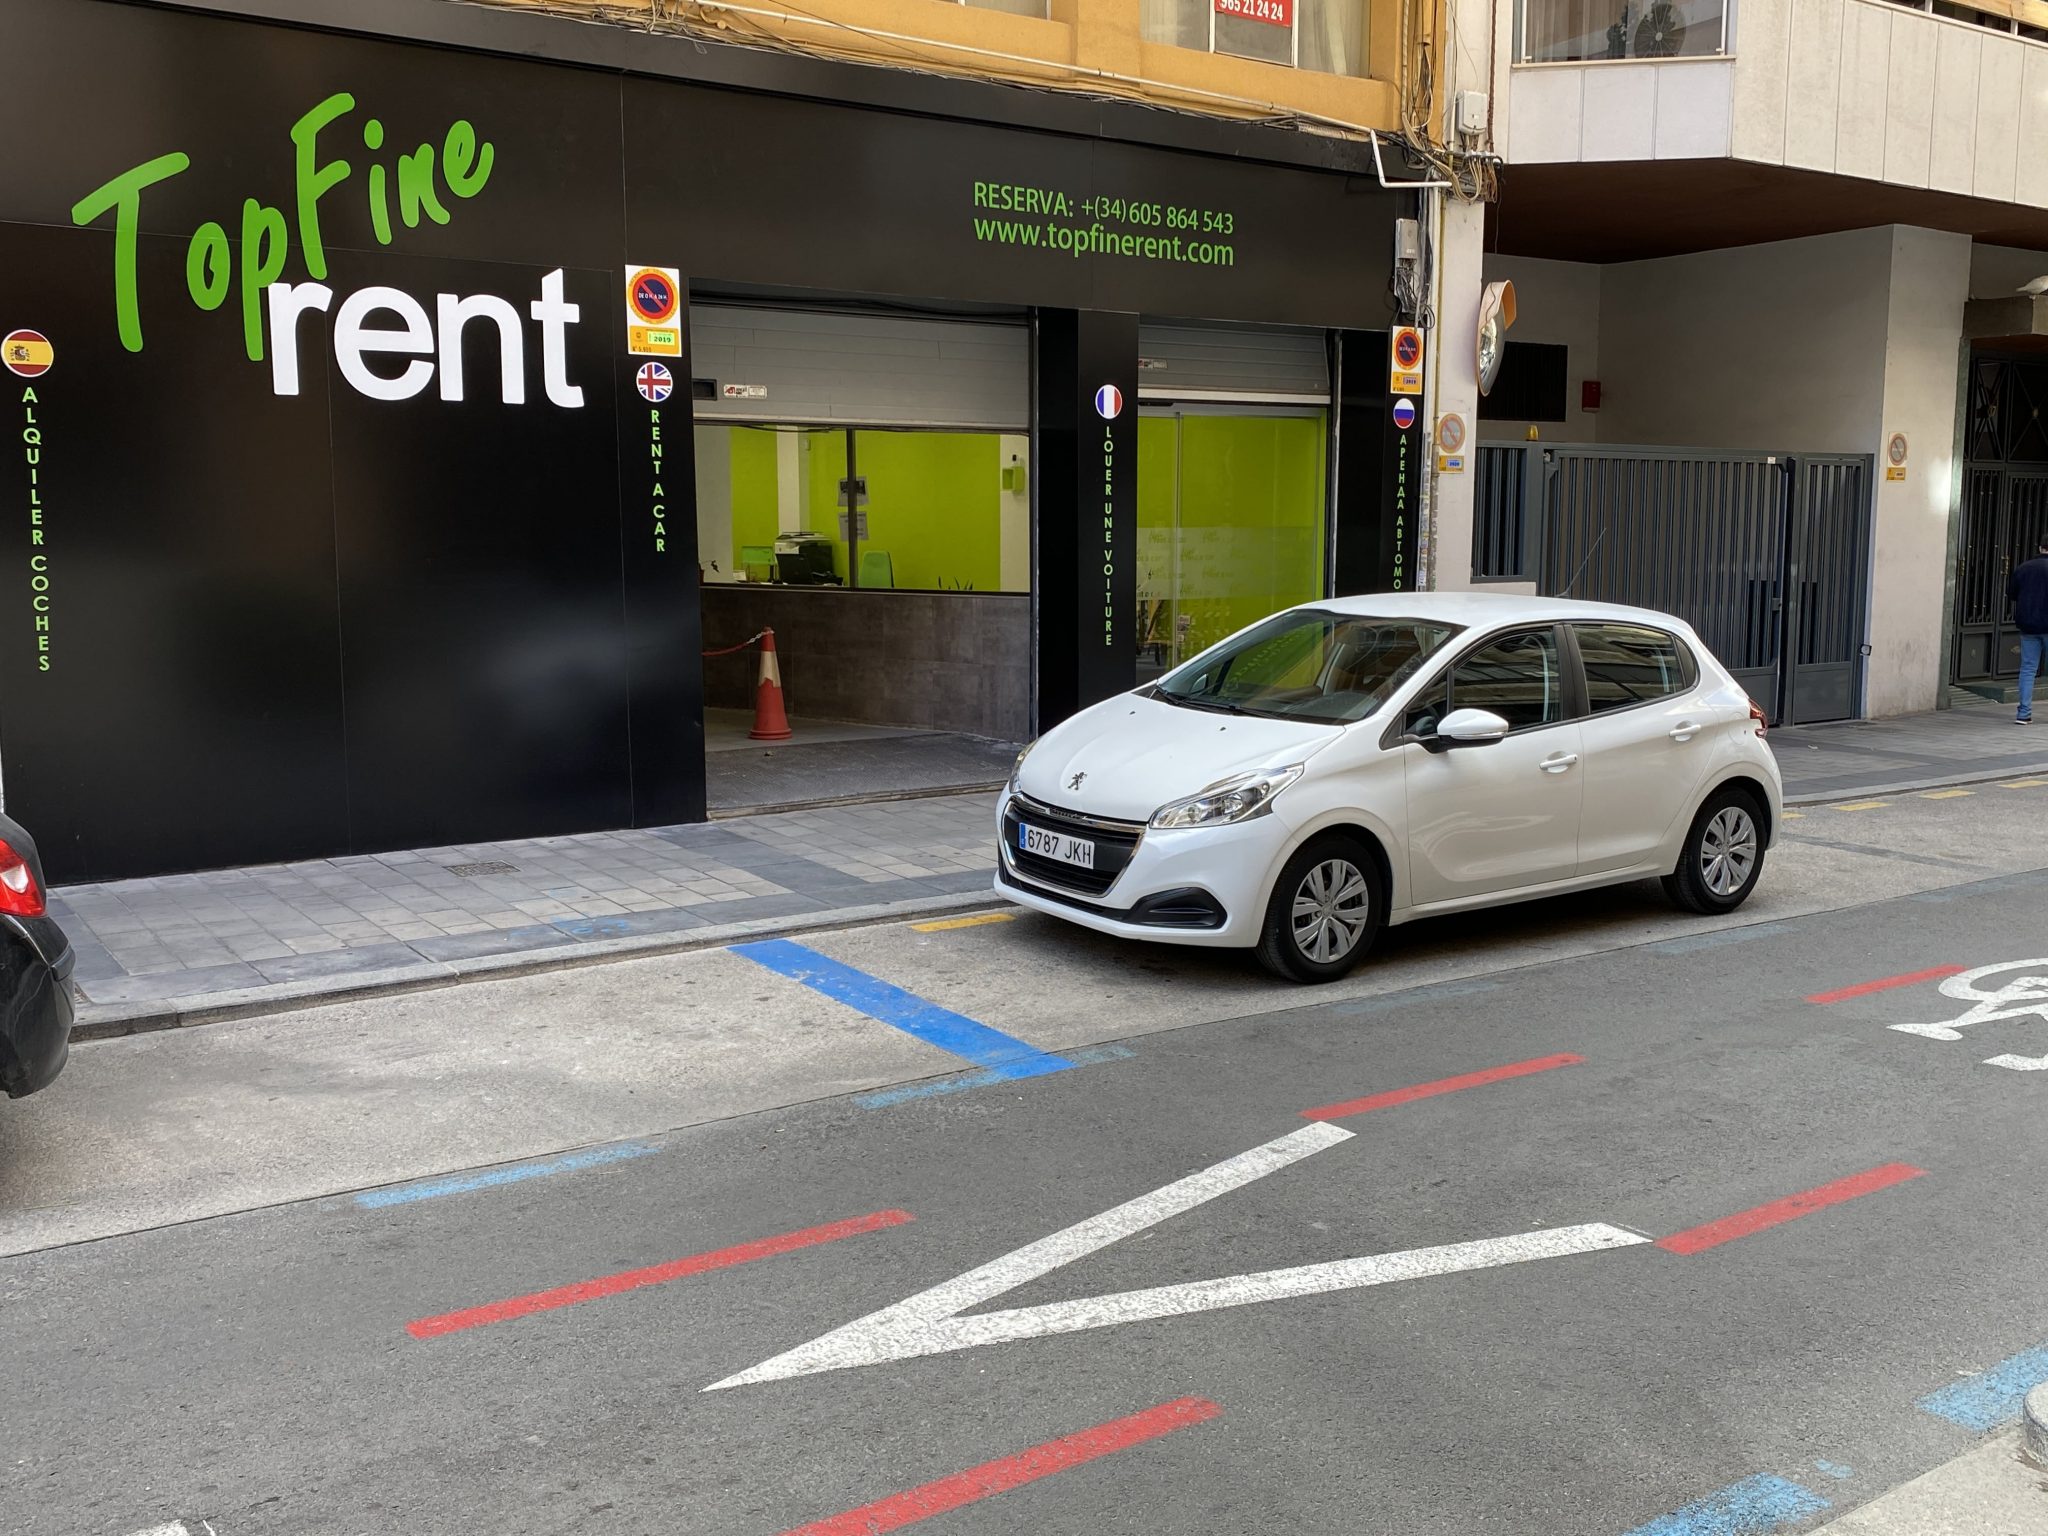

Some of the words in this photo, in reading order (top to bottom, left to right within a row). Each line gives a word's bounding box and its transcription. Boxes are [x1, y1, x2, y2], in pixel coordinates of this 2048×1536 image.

[1242, 0, 1255, 15] 21
[1257, 0, 1269, 18] 24
[1271, 3, 1283, 21] 24
[974, 181, 1073, 217] RESERVA:
[1166, 206, 1199, 230] 864
[1202, 210, 1234, 235] 543
[973, 218, 1234, 266] www.topfinerent.com
[268, 267, 586, 410] rent
[653, 335, 672, 343] 2019
[22, 387, 44, 546] ALQUILER
[650, 409, 663, 475] RENT
[1103, 426, 1114, 496] LOUER
[652, 482, 664, 497] A
[652, 504, 665, 552] CAR
[1104, 502, 1113, 543] UNE
[30, 555, 50, 672] COCHES
[1103, 549, 1114, 646] VOITURE
[1028, 829, 1059, 855] 6787
[1064, 840, 1091, 865] JKH
